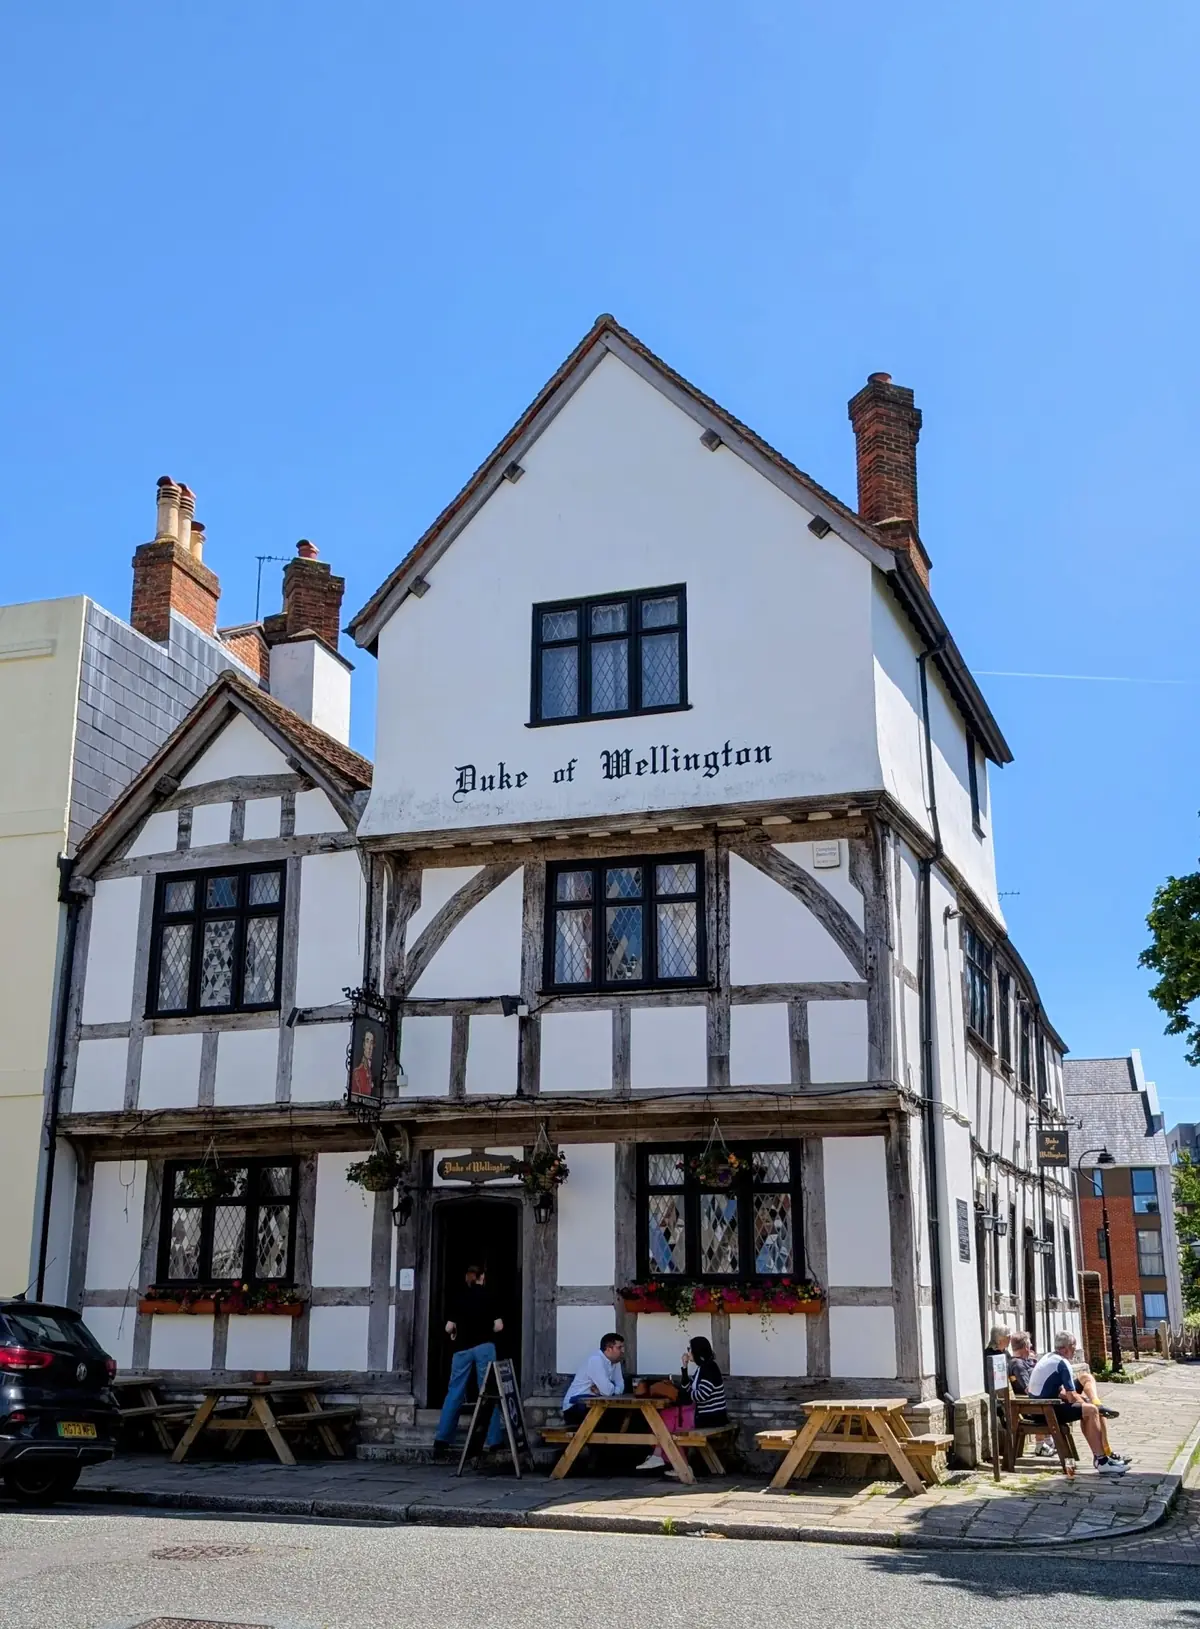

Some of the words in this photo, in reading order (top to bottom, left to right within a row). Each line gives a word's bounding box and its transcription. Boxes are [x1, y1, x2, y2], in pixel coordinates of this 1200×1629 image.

[452, 762, 529, 804] Duke
[552, 758, 579, 784] of
[600, 740, 773, 780] Wellington
[443, 1161, 464, 1176] Duke
[465, 1161, 472, 1172] of
